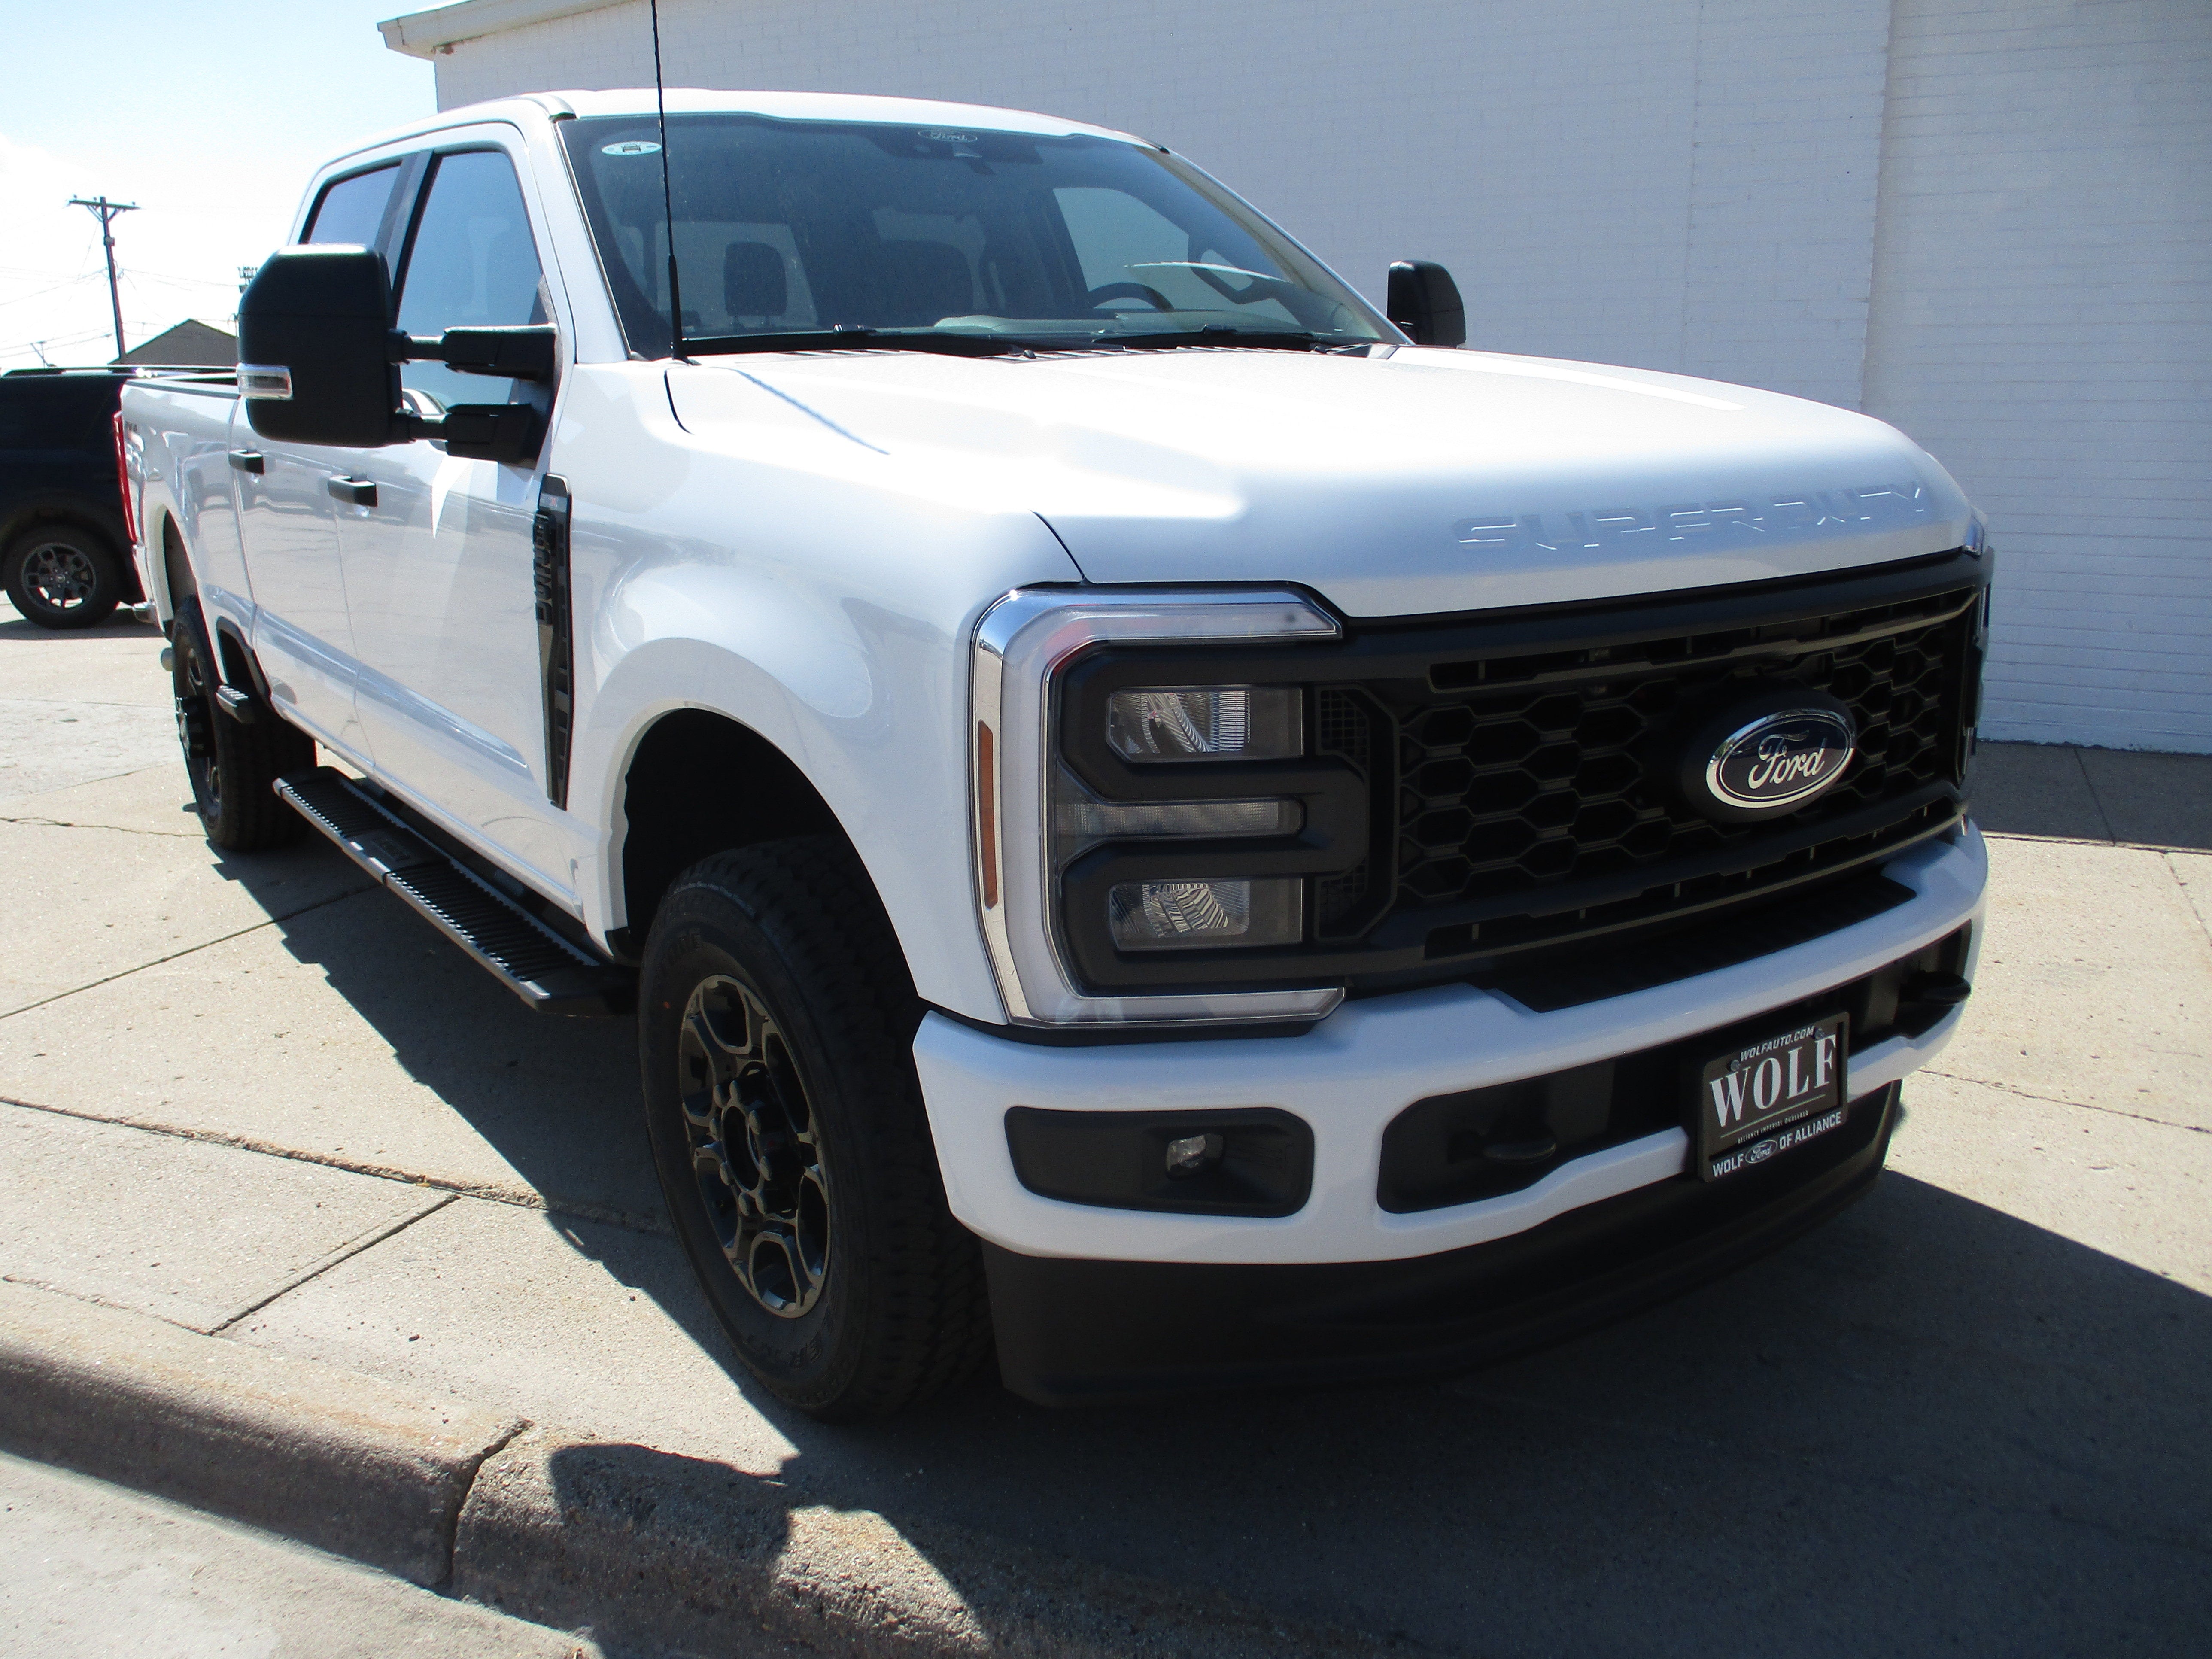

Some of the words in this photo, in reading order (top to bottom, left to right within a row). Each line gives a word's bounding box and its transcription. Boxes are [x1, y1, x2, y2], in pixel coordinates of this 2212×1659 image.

[1451, 499, 1765, 551] SUPER
[1769, 481, 1927, 529] DUTY
[1747, 730, 1828, 790] Ford
[1741, 1025, 1815, 1062] WOLFAUTO.COM
[1710, 1034, 1836, 1127] WOLF
[1712, 1153, 1744, 1178] WOLF
[1750, 1142, 1772, 1162] Ford
[1779, 1133, 1793, 1150] OF
[1794, 1111, 1842, 1144] ALLIANCE
[1737, 1130, 1759, 1144] ALLIANCE
